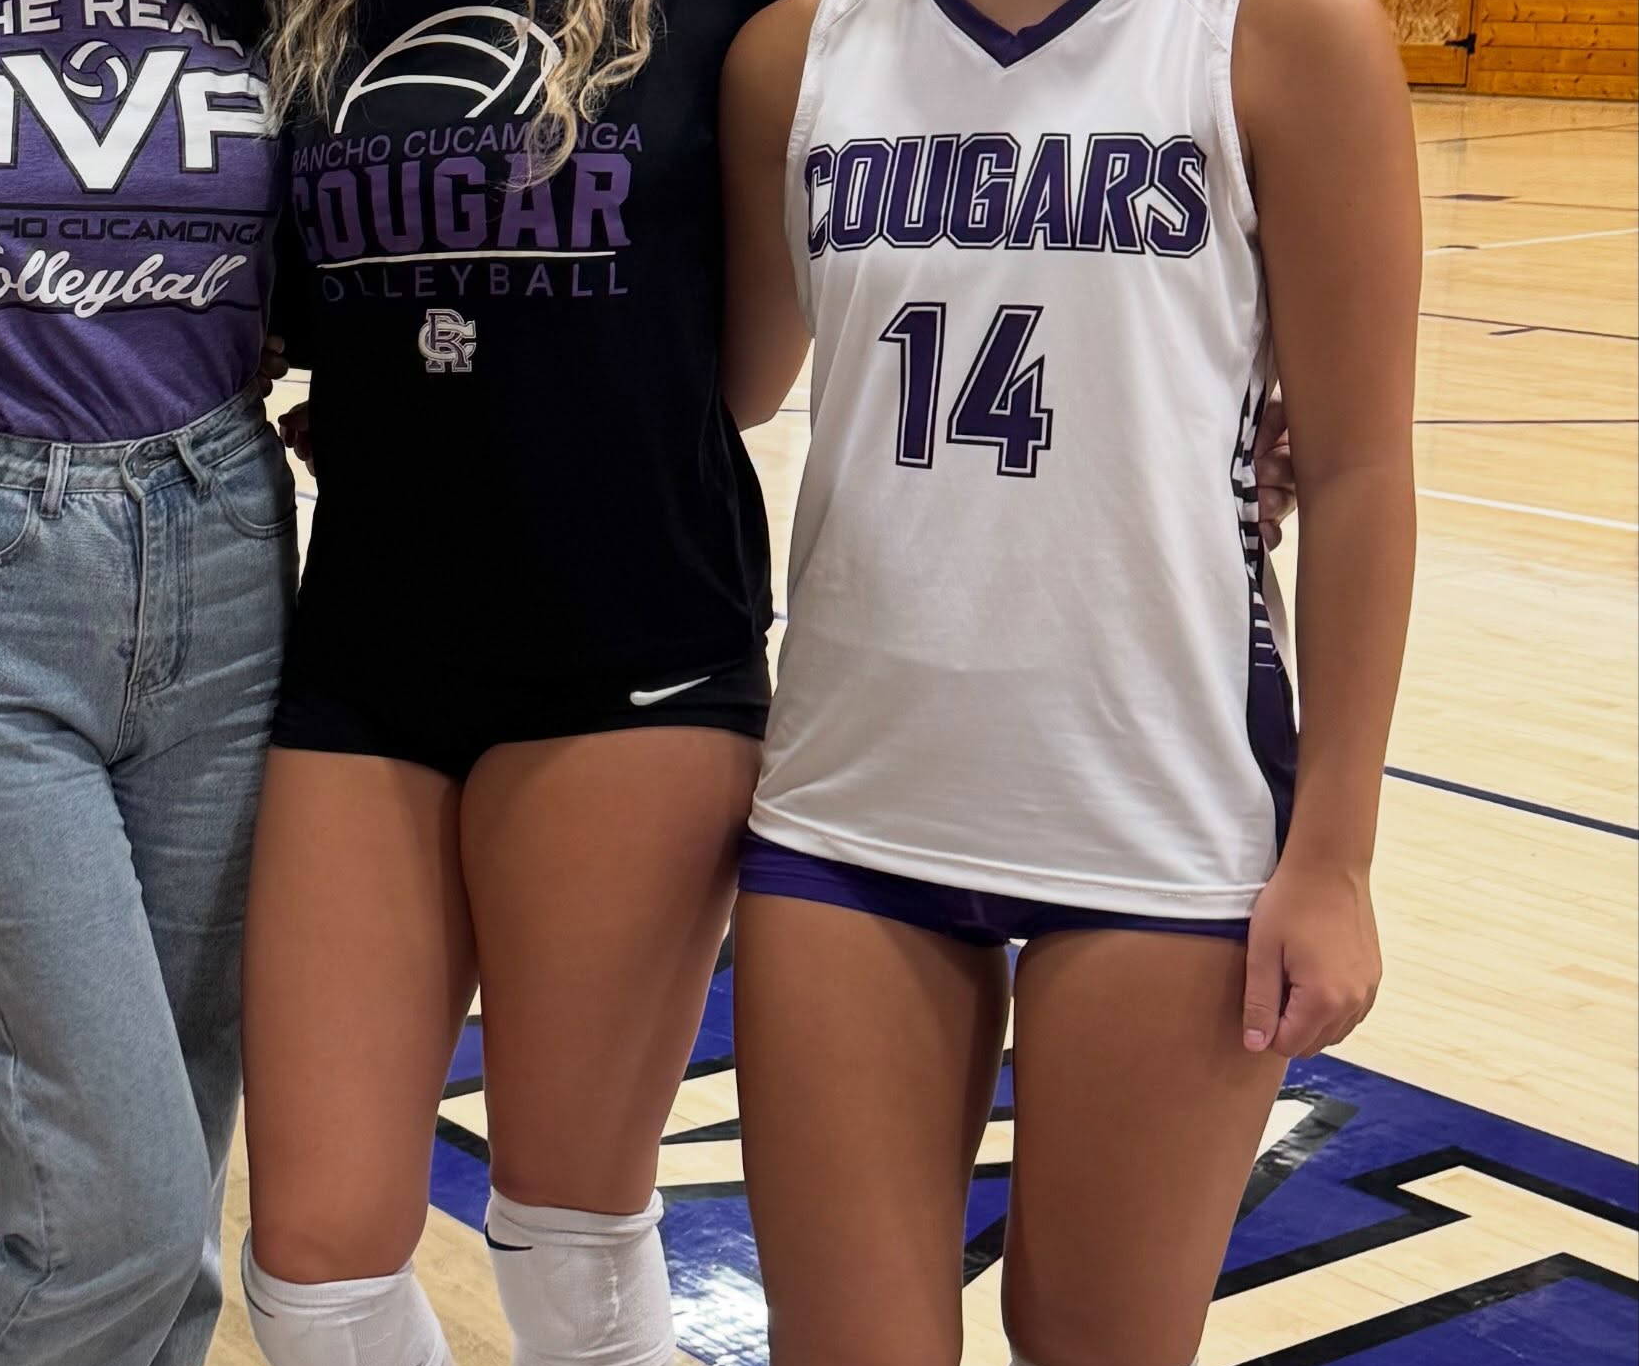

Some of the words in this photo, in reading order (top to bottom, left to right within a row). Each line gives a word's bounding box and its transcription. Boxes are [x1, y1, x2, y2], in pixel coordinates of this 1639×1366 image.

[292, 134, 390, 172] RANCHO
[292, 153, 632, 262] COUGAR
[805, 132, 1211, 260] COUGARS
[322, 262, 628, 303] OLLEYBALL
[879, 301, 1053, 478] 14
